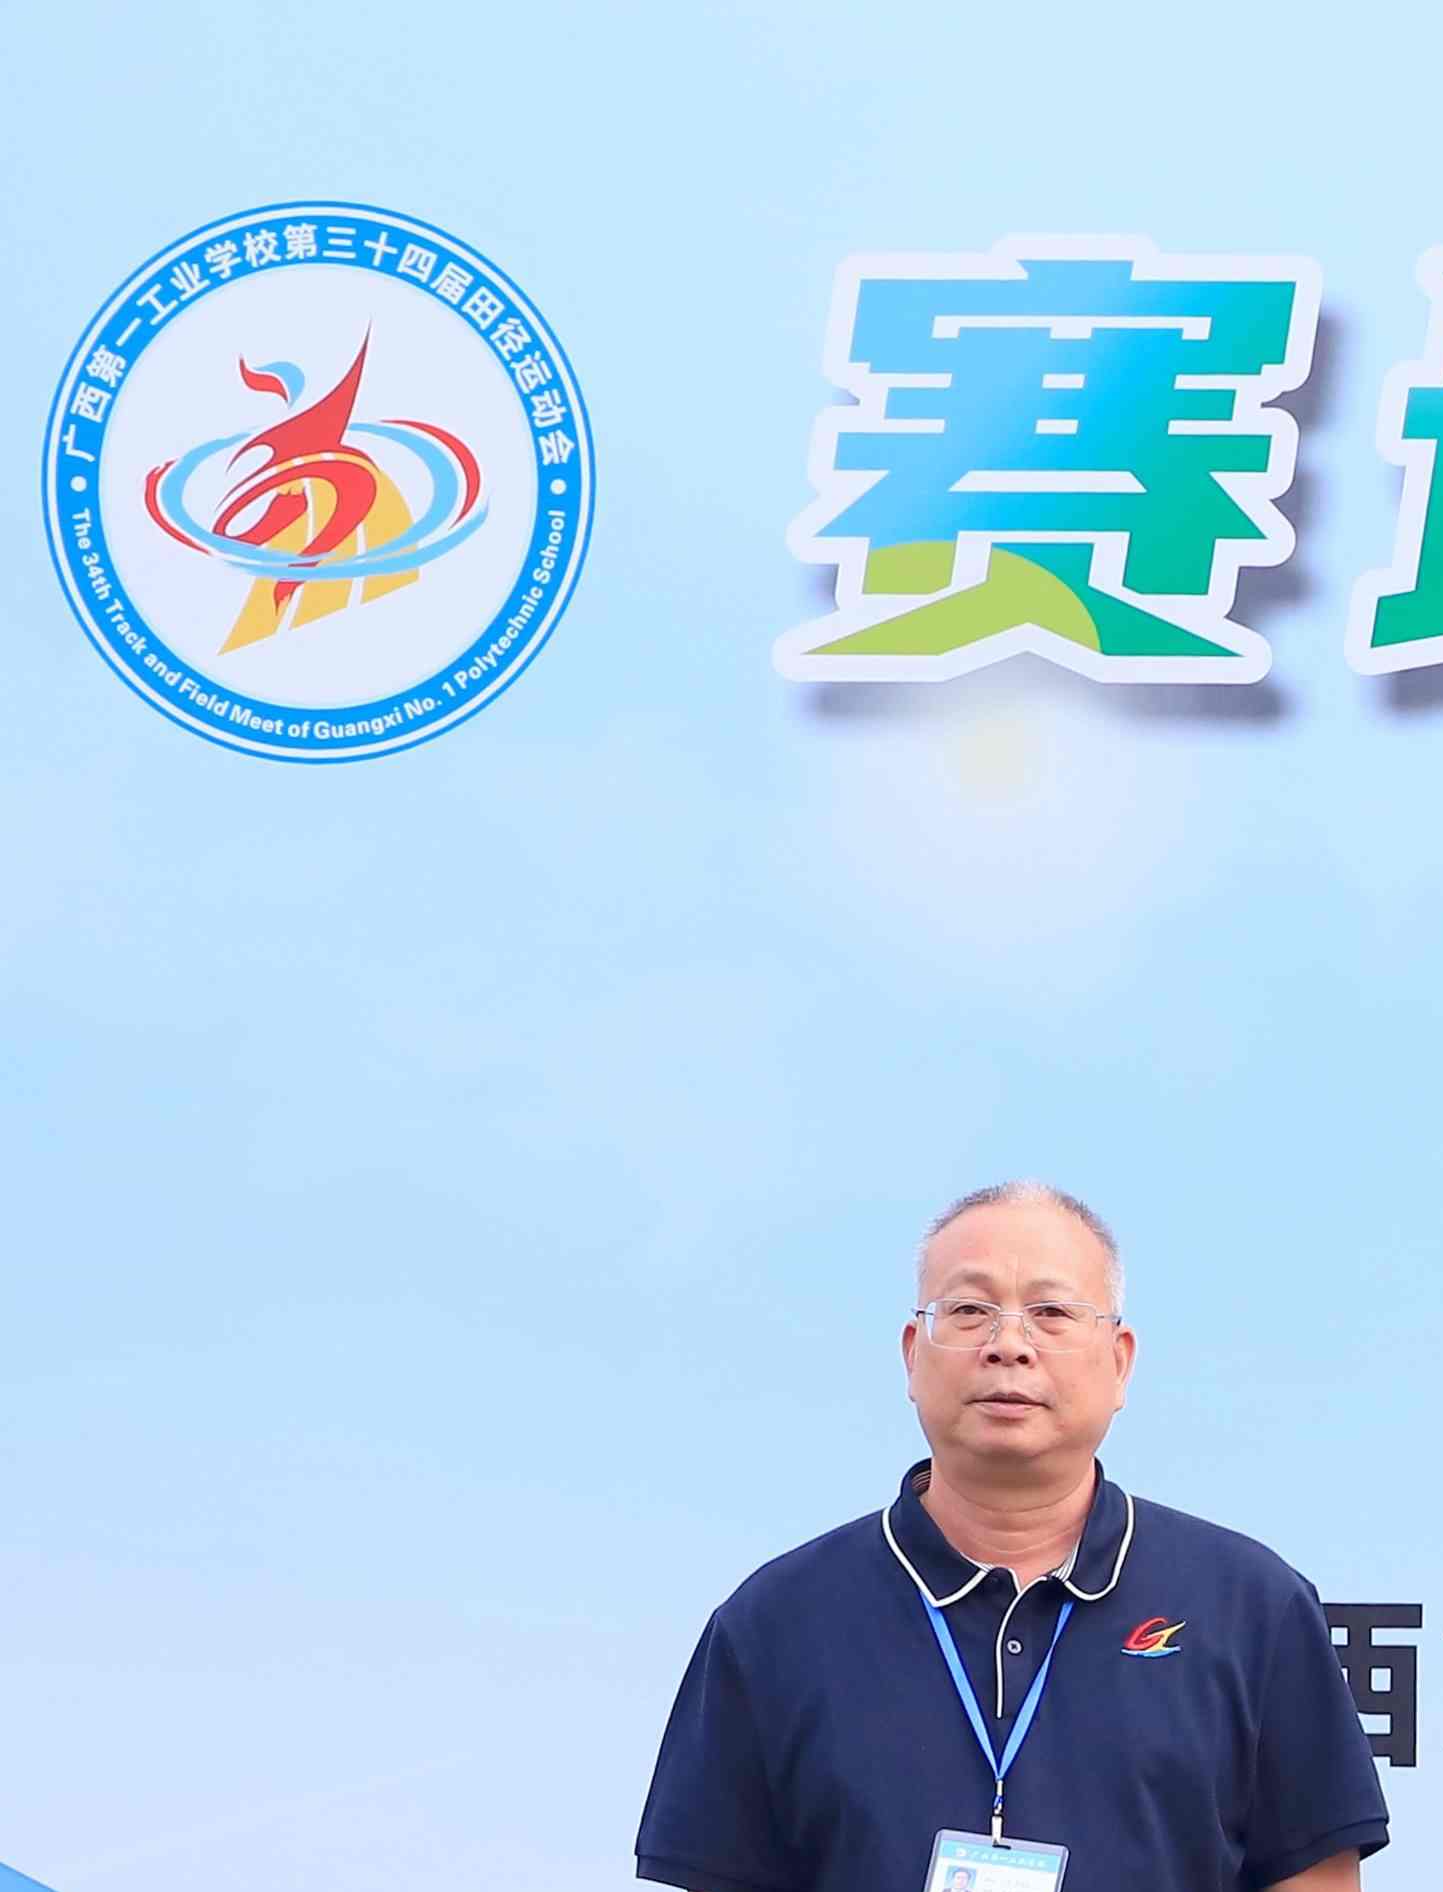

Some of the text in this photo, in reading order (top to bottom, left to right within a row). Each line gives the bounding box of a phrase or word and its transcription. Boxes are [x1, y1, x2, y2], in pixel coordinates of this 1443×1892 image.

[62, 223, 575, 466] 广西第一工业学校第三十四届田径运动会
[72, 508, 566, 740] The 34th Track and Field Meet of Guangxi No. 1 Polytechnic School
